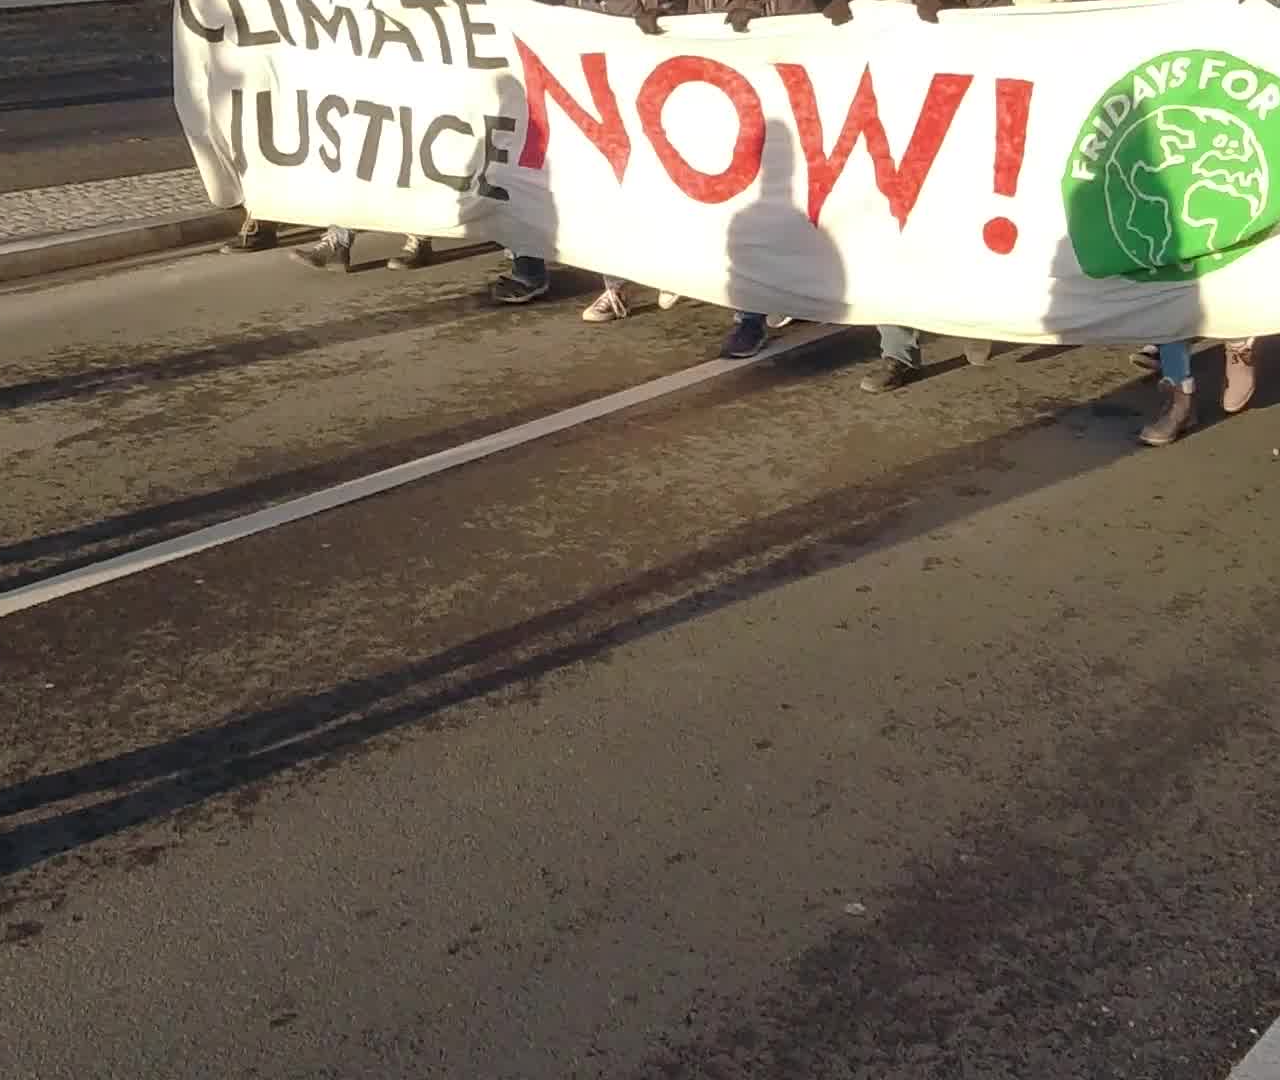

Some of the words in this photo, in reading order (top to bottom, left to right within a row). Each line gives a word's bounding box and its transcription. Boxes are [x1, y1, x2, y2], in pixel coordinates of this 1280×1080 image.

[512, 31, 1034, 255] NOW!
[1071, 57, 1191, 180] FRIDAYS
[1199, 57, 1280, 120] FOR
